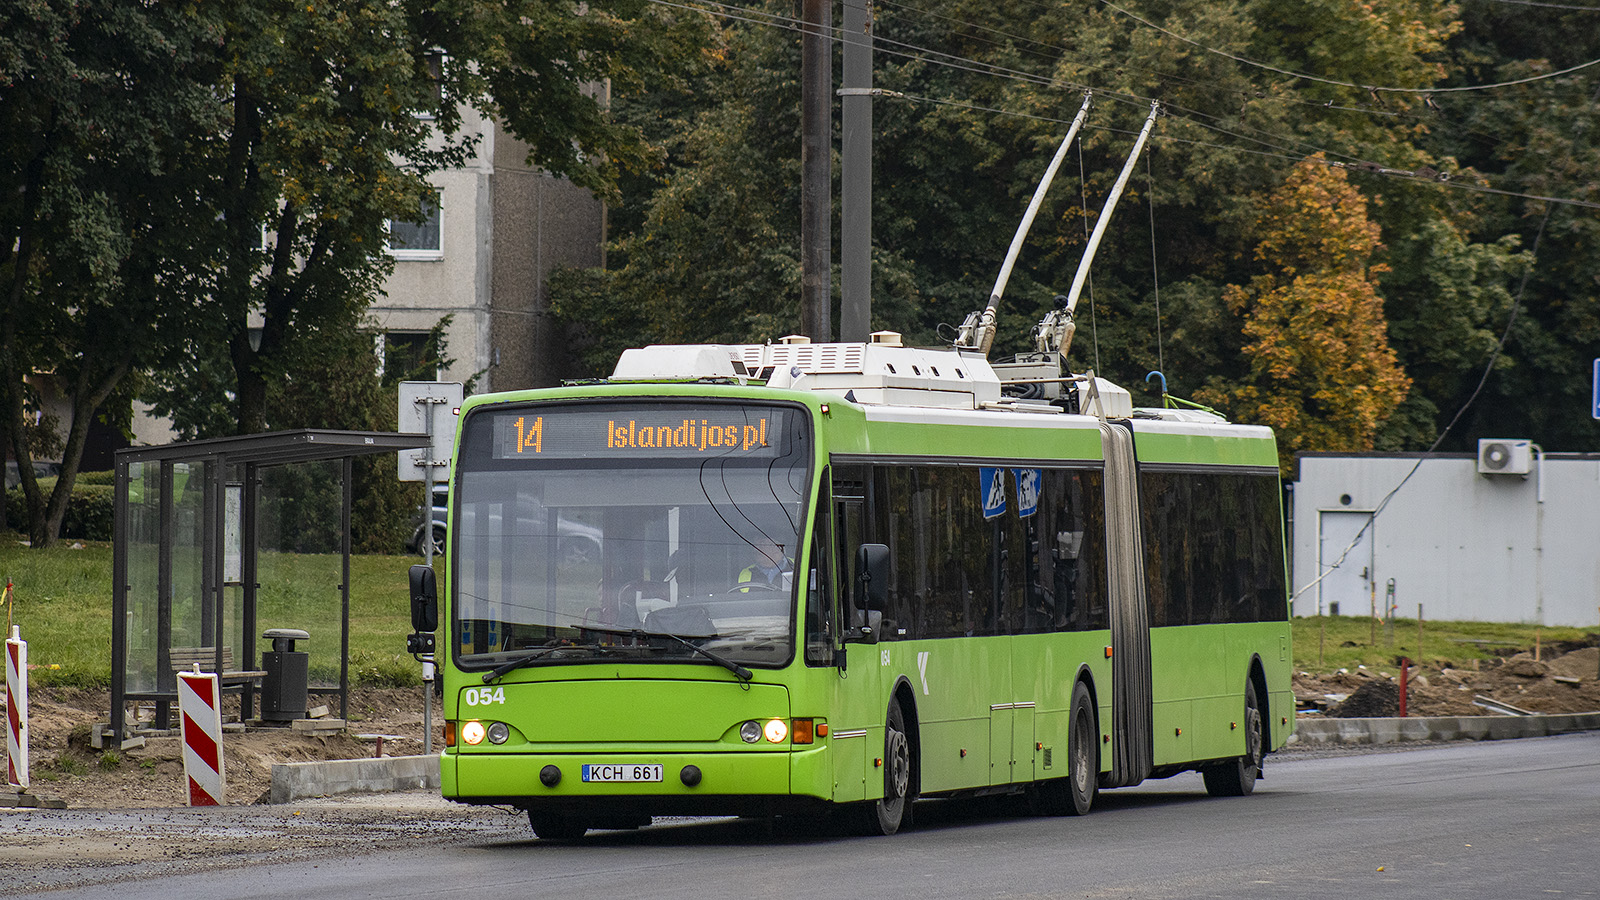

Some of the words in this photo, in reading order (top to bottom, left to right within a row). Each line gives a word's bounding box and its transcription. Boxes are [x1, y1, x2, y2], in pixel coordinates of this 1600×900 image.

[514, 417, 543, 453] 14
[607, 419, 738, 451] Islandijos
[742, 418, 769, 451] pl
[881, 650, 890, 666] 054
[466, 687, 505, 706] 054
[591, 766, 623, 780] KCH
[633, 766, 659, 780] 661
